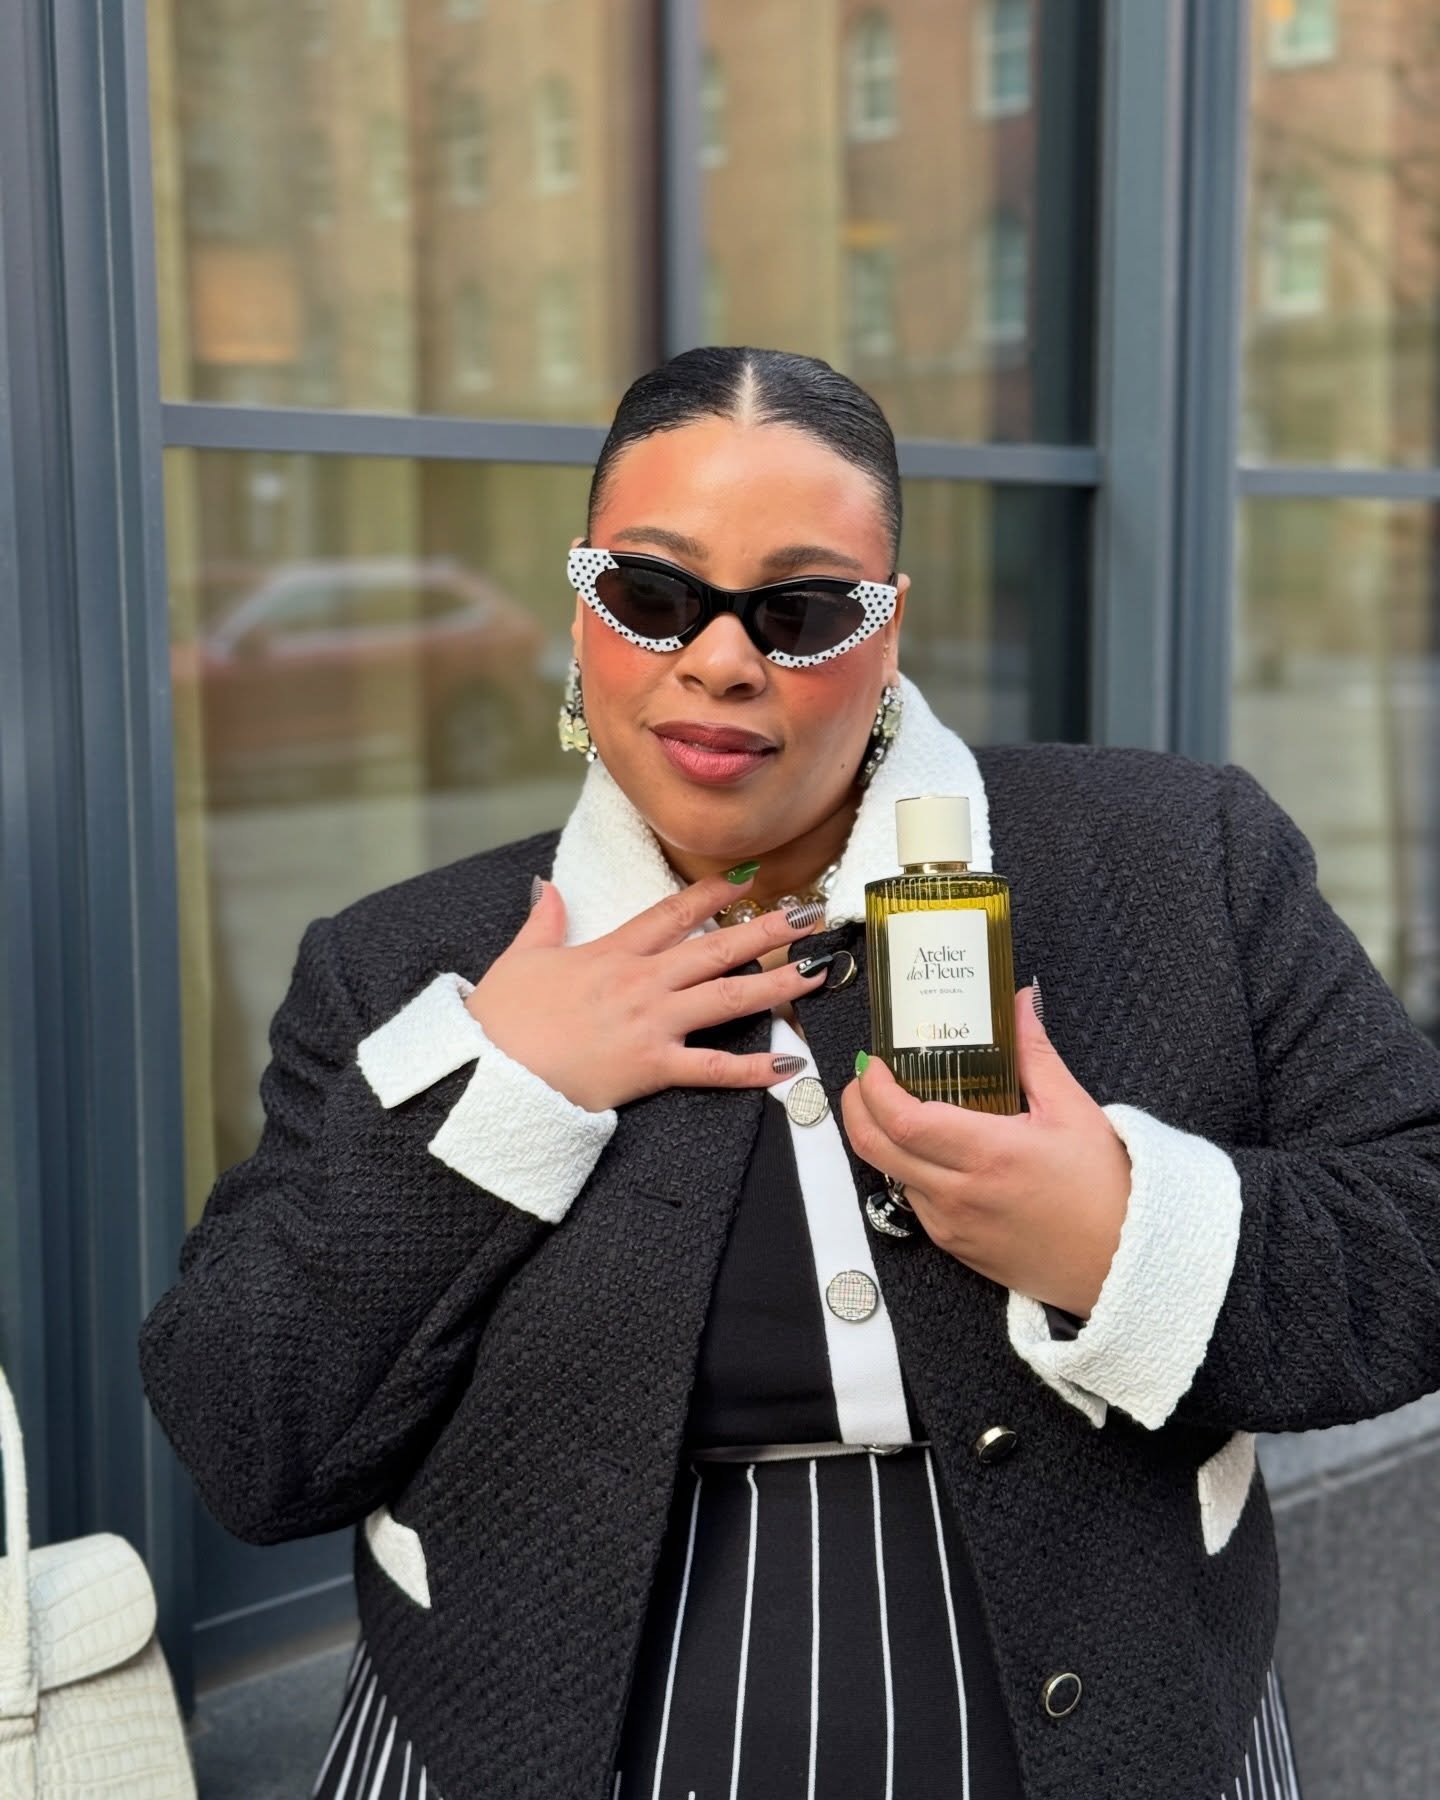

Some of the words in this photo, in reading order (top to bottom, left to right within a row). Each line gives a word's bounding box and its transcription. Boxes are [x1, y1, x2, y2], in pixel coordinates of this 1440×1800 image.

[914, 945, 966, 964] Atelier
[907, 966, 923, 981] des
[925, 963, 975, 980] Fleurs
[916, 1023, 970, 1040] Chloé
